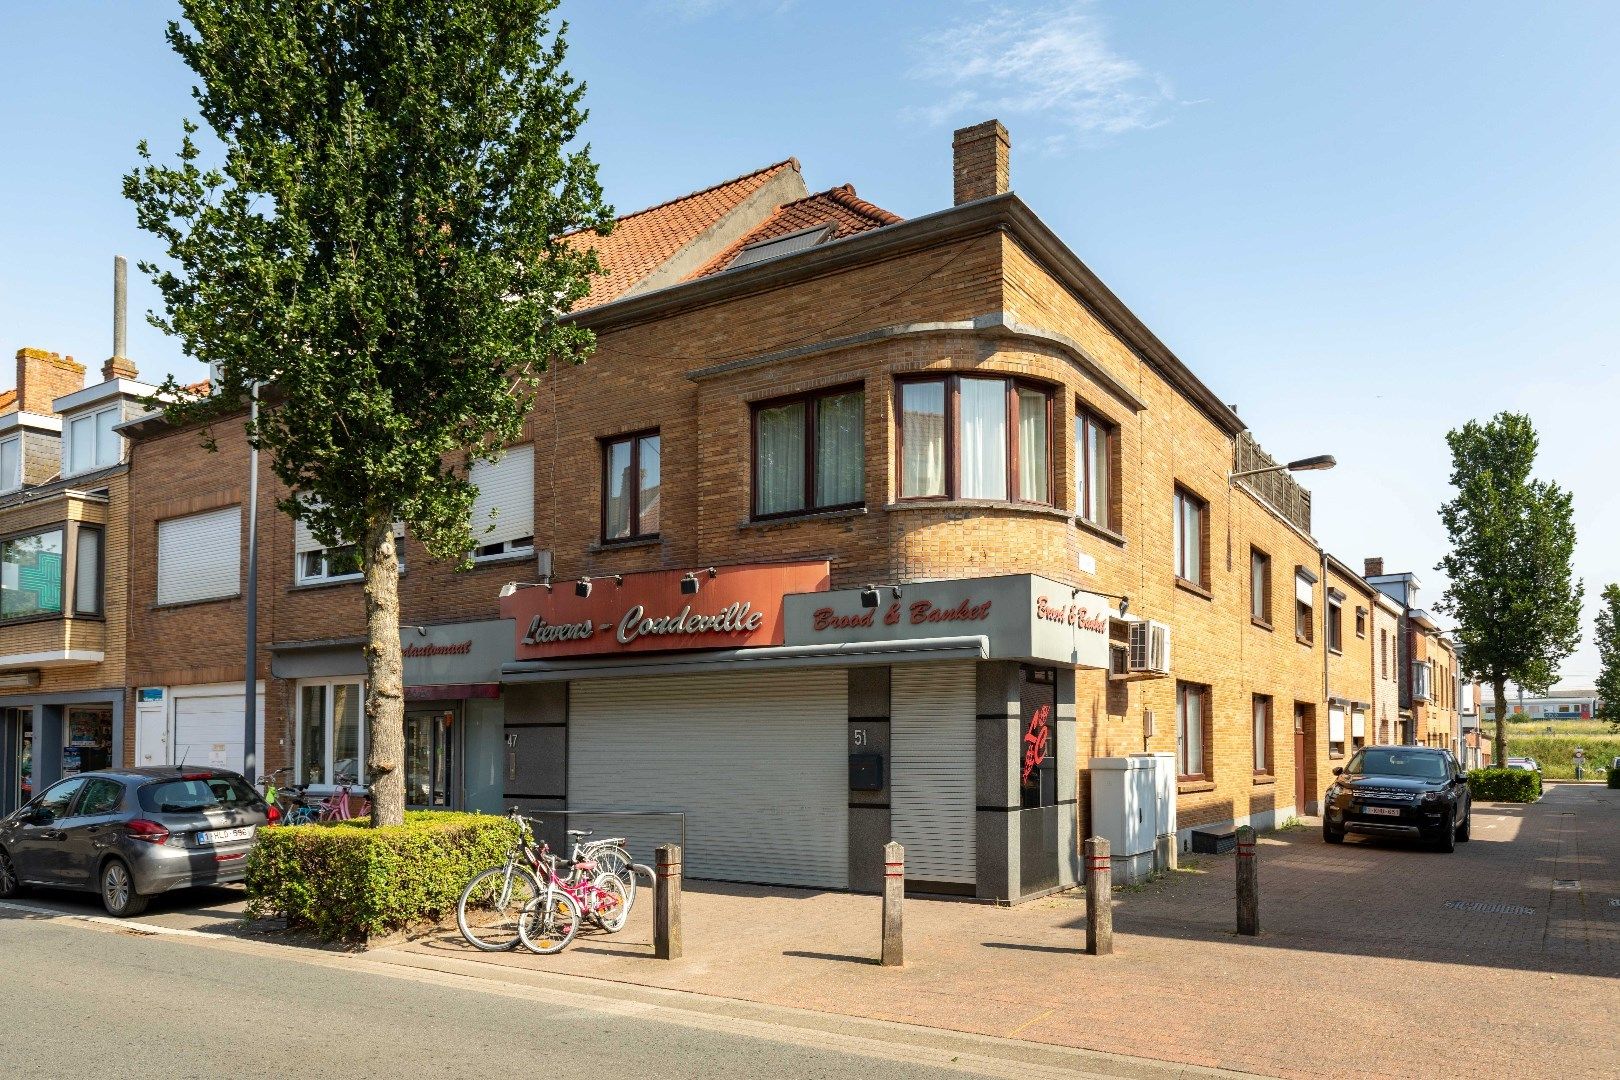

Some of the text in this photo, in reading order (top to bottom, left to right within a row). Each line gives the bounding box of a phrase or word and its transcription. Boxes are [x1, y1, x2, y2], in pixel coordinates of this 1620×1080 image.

[813, 598, 992, 631] Brood & Banket
[1036, 595, 1107, 634] Brood & Banket
[521, 614, 594, 645] Lievens
[401, 640, 473, 658] dautomaat
[507, 734, 518, 748] 47
[854, 729, 867, 746] 51
